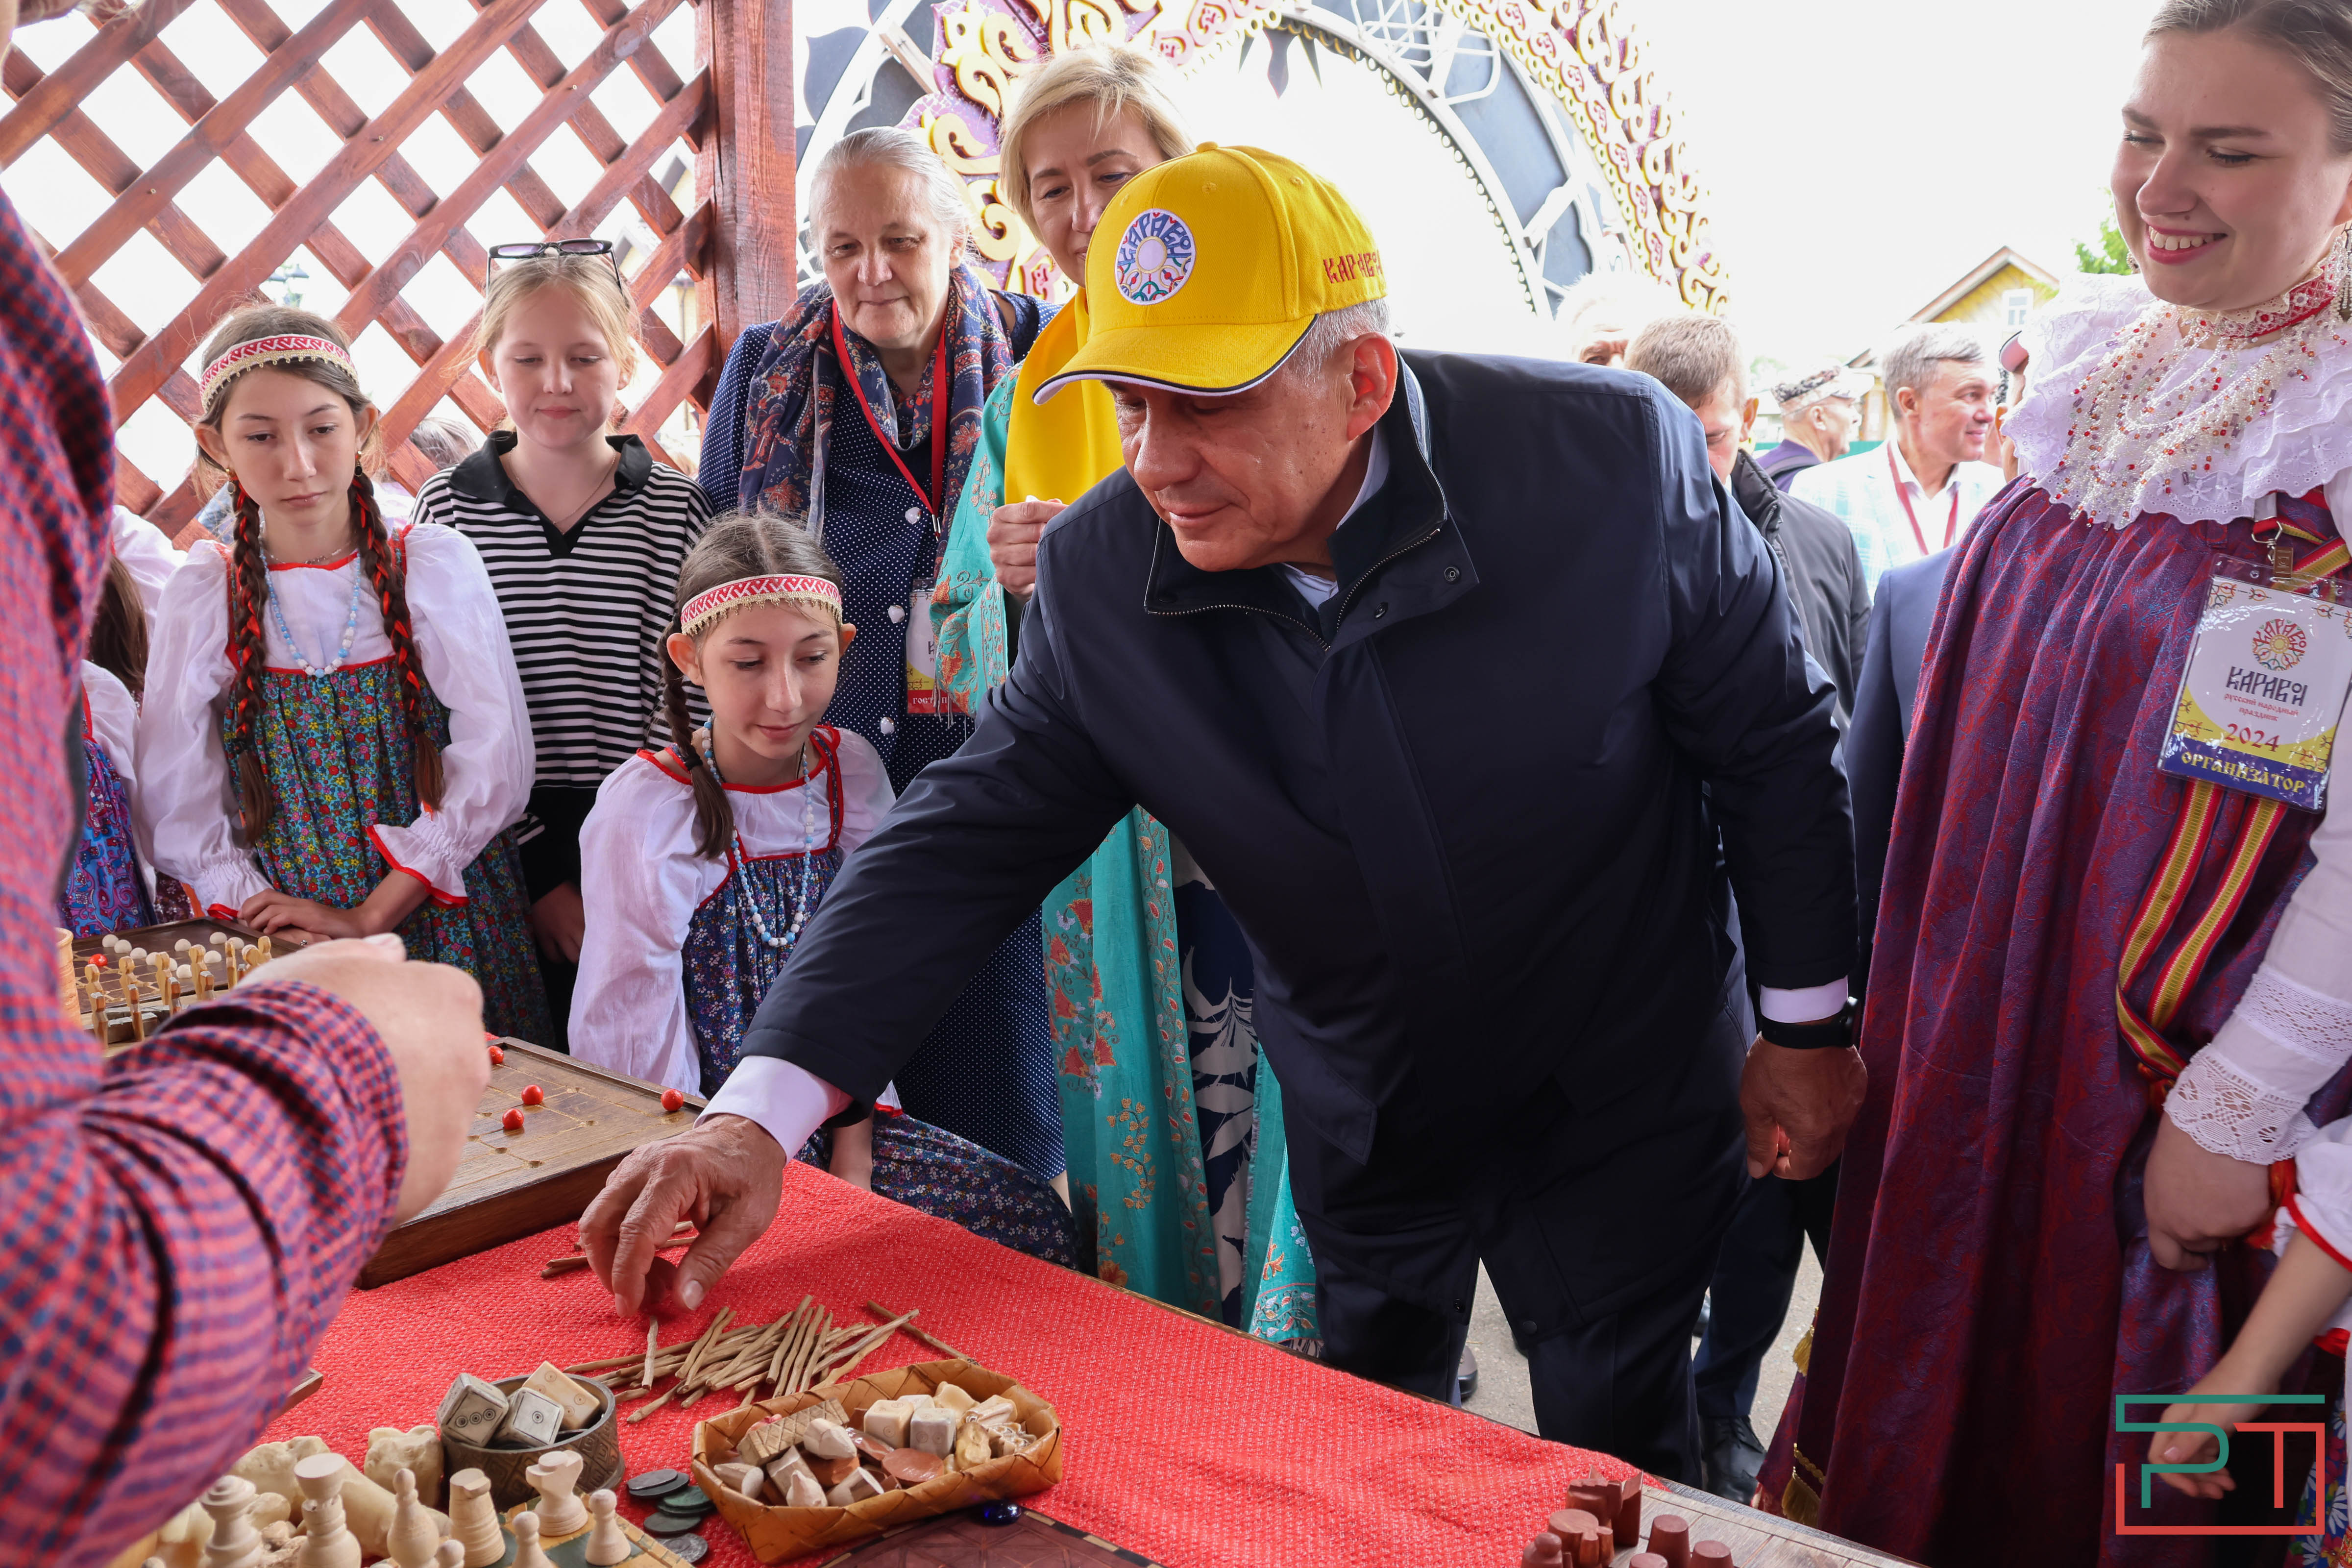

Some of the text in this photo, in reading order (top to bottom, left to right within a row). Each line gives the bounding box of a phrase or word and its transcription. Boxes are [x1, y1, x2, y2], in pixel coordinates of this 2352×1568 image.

[2224, 693, 2256, 706] русский
[2238, 707, 2278, 722] праздник
[2225, 723, 2280, 752] 2024
[2181, 751, 2305, 792] ОРГАНИЗАТОР
